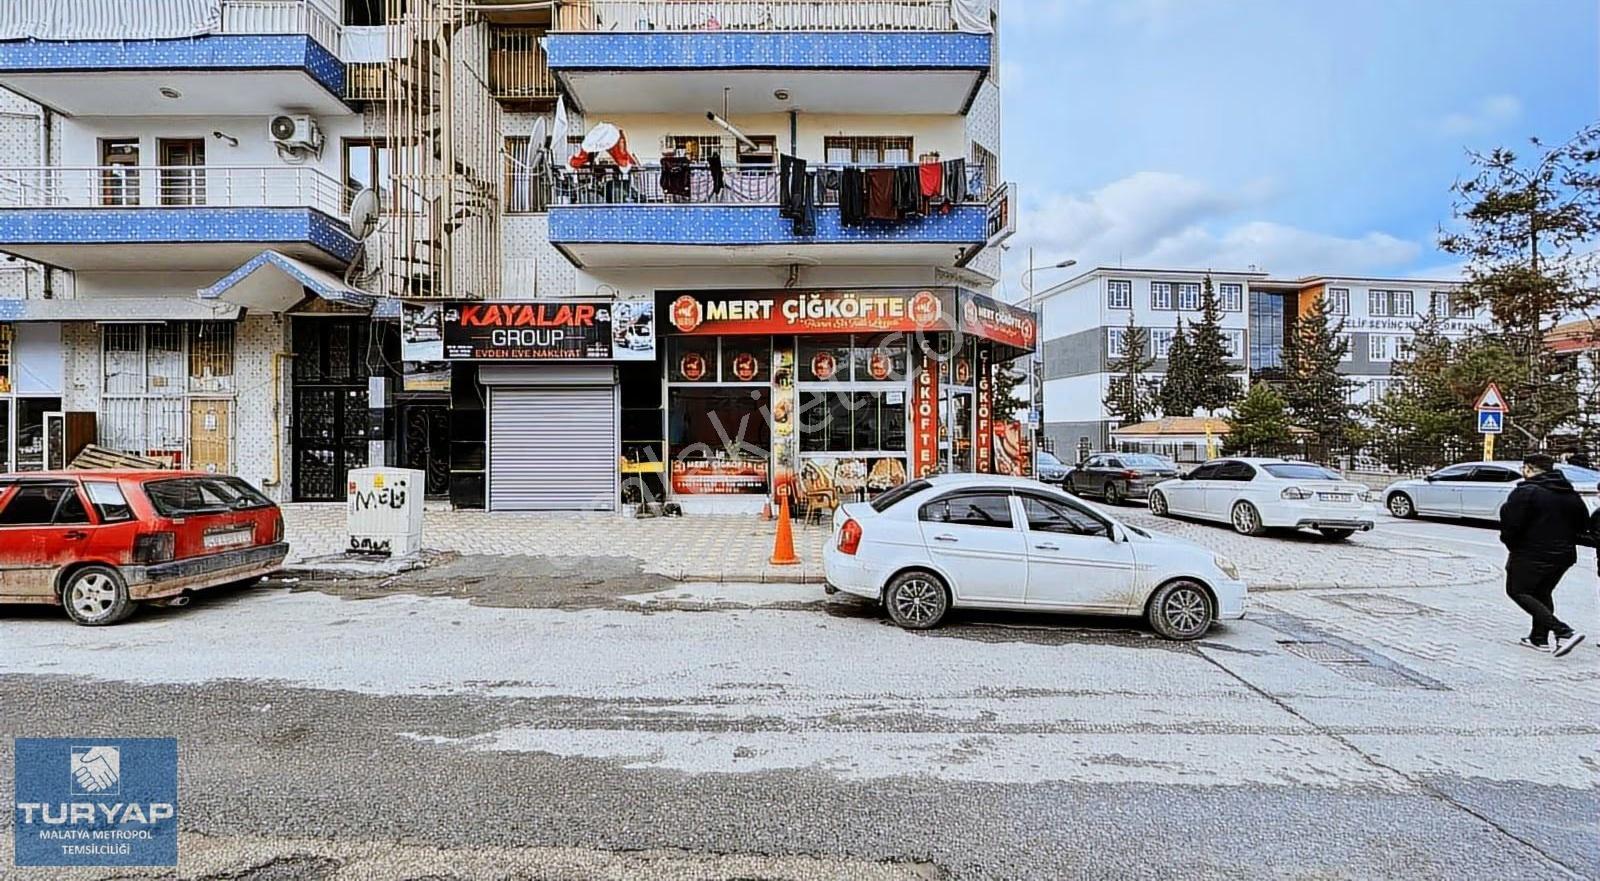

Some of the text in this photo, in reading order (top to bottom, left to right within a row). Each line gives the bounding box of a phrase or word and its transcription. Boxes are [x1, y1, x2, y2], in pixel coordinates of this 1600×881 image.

[460, 304, 595, 327] KAYALAR
[706, 299, 774, 320] MERT
[782, 293, 904, 324] ÇİĞKÖFTE
[492, 328, 564, 347] GROUP
[475, 348, 508, 358] EVDEN
[511, 348, 532, 358] EVE
[533, 347, 581, 358] NAKLİYAT
